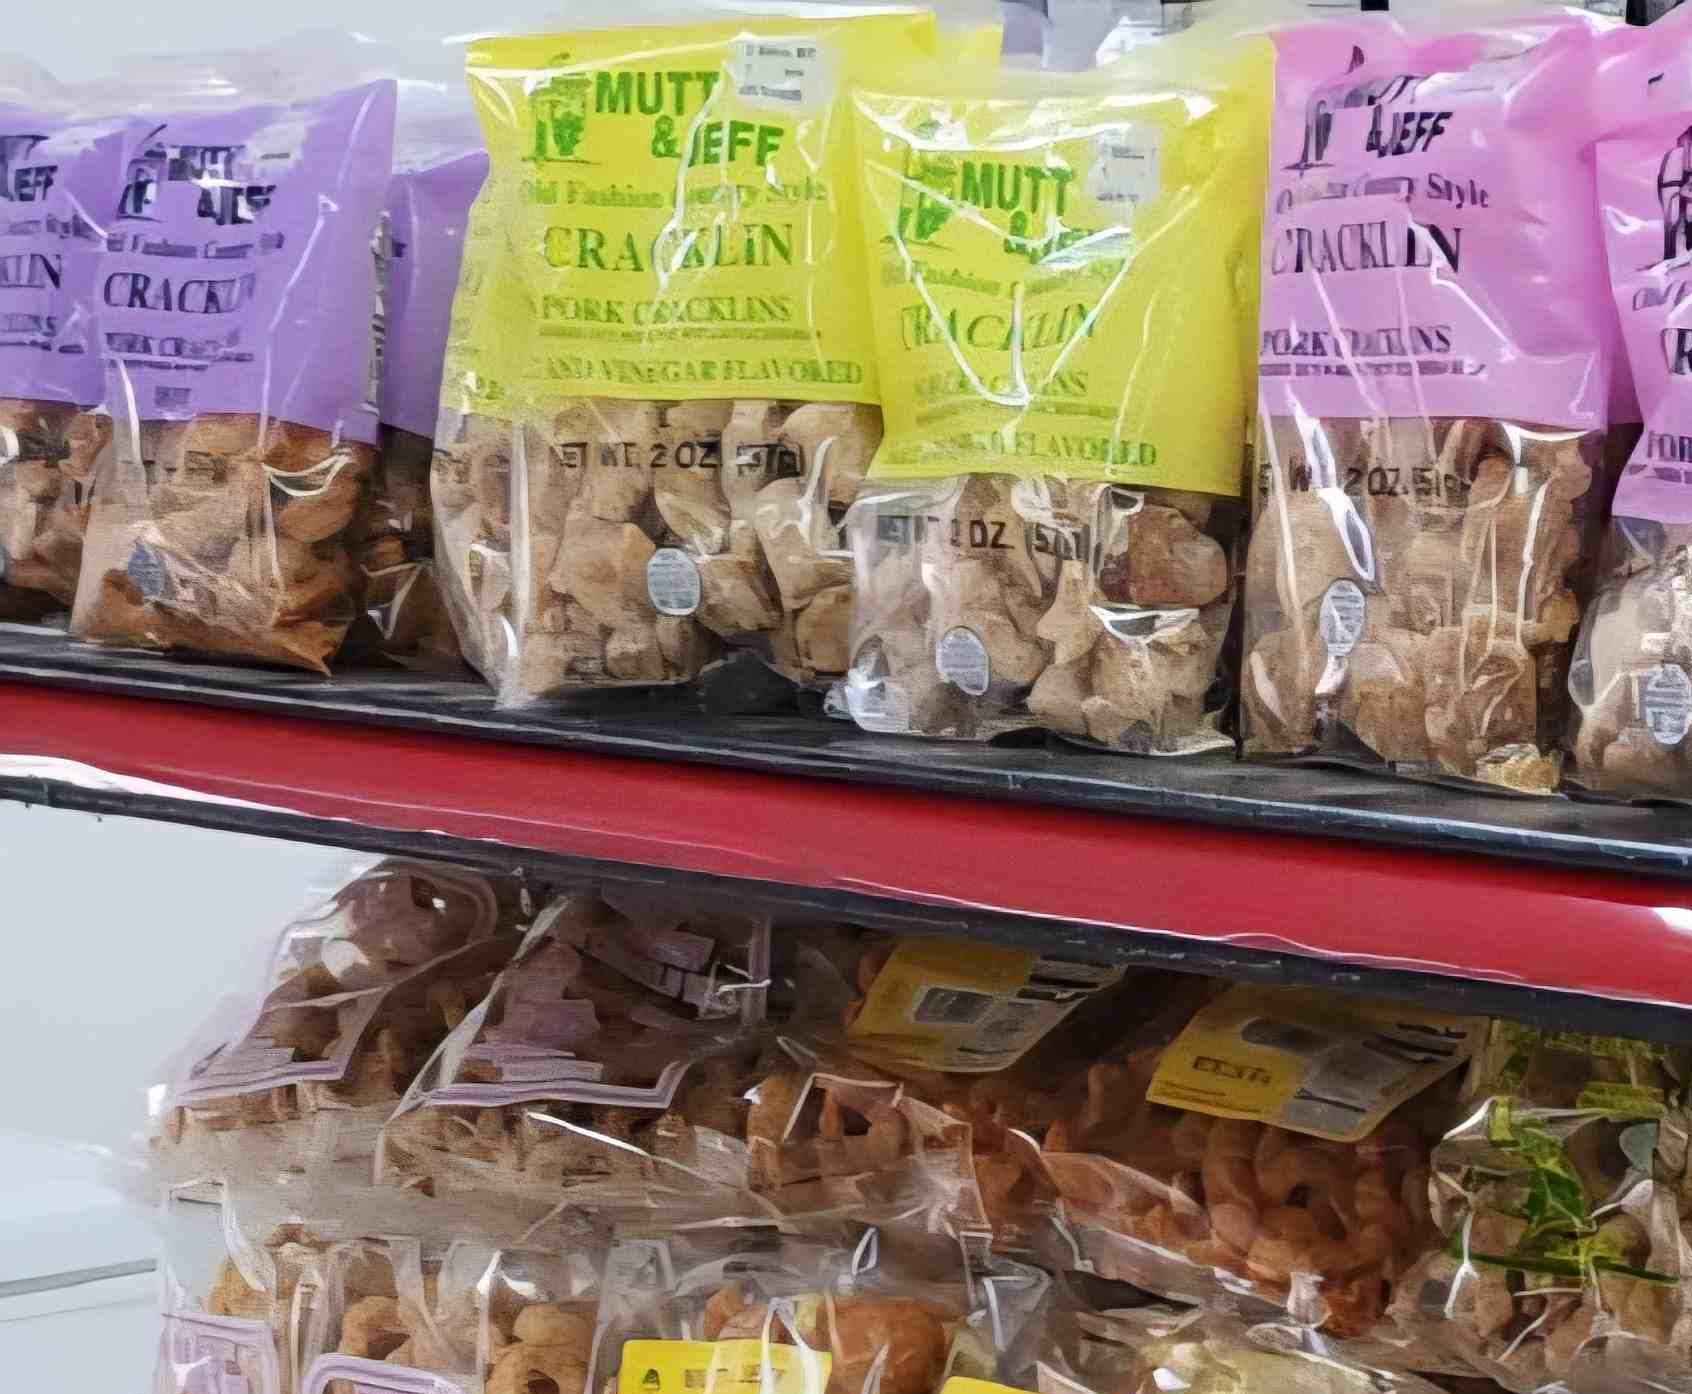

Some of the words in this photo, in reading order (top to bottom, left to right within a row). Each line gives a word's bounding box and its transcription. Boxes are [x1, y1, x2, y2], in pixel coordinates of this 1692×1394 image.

[595, 71, 720, 116] MUTT
[651, 115, 681, 158] &
[962, 160, 1072, 216] MUTT
